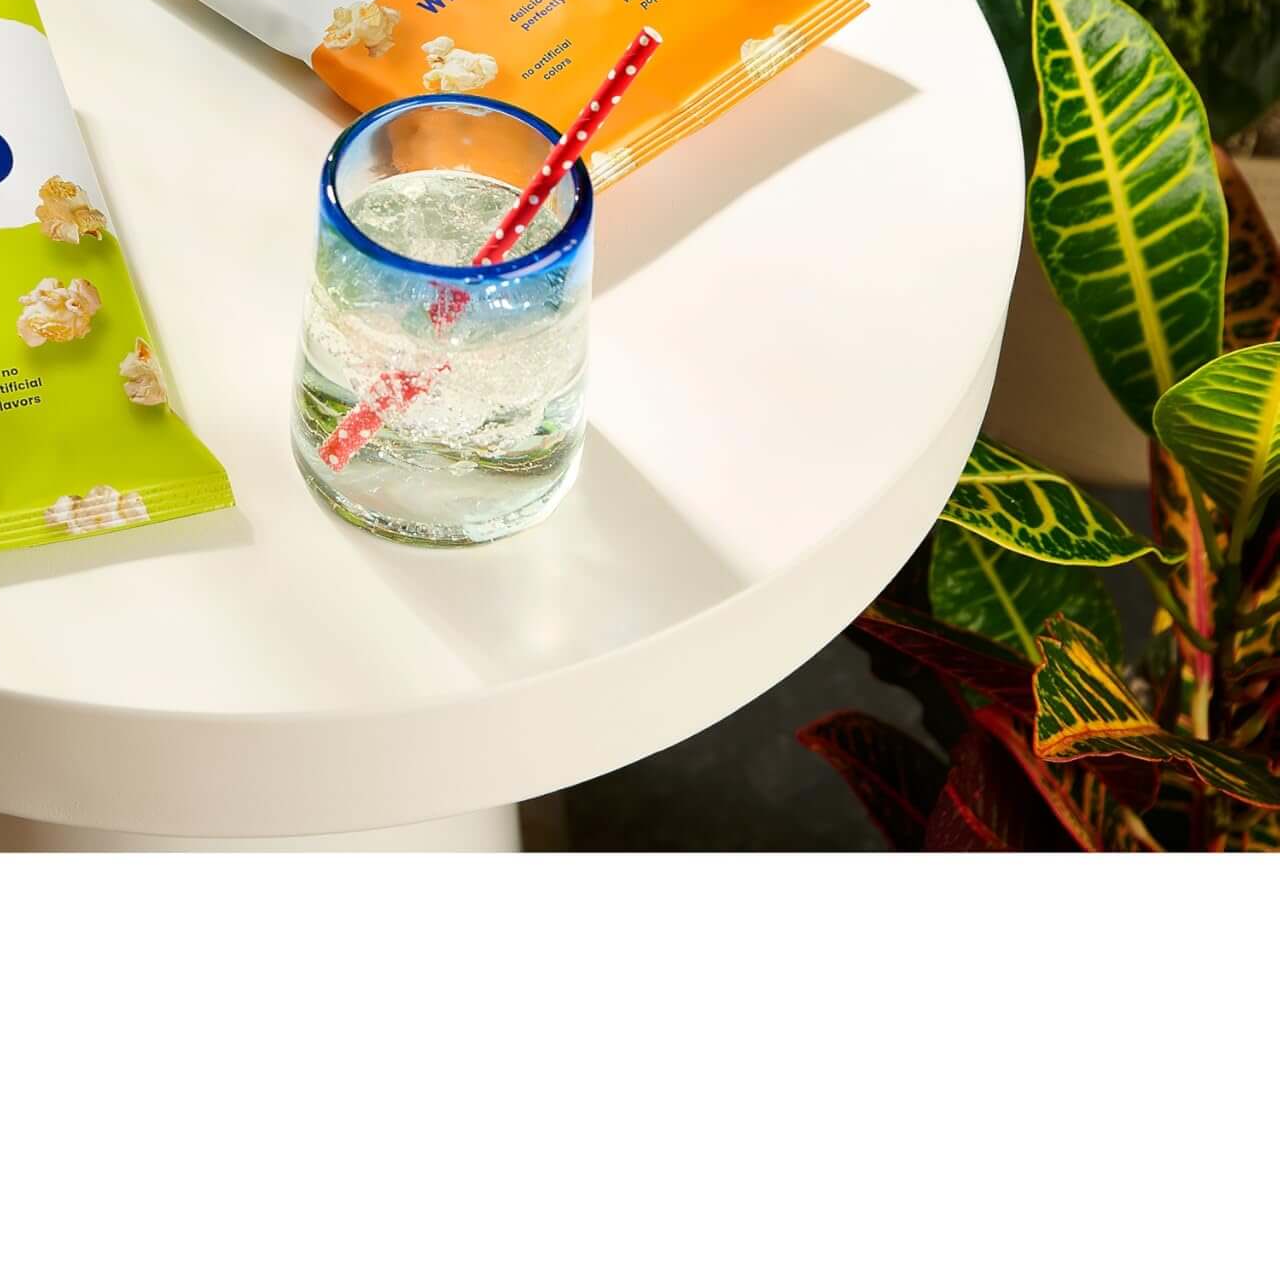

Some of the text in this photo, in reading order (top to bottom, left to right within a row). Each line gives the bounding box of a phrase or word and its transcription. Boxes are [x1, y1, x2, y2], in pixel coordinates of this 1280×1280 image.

[521, 38, 573, 80] no artificial
[543, 57, 572, 81] colors
[1, 367, 19, 378] no
